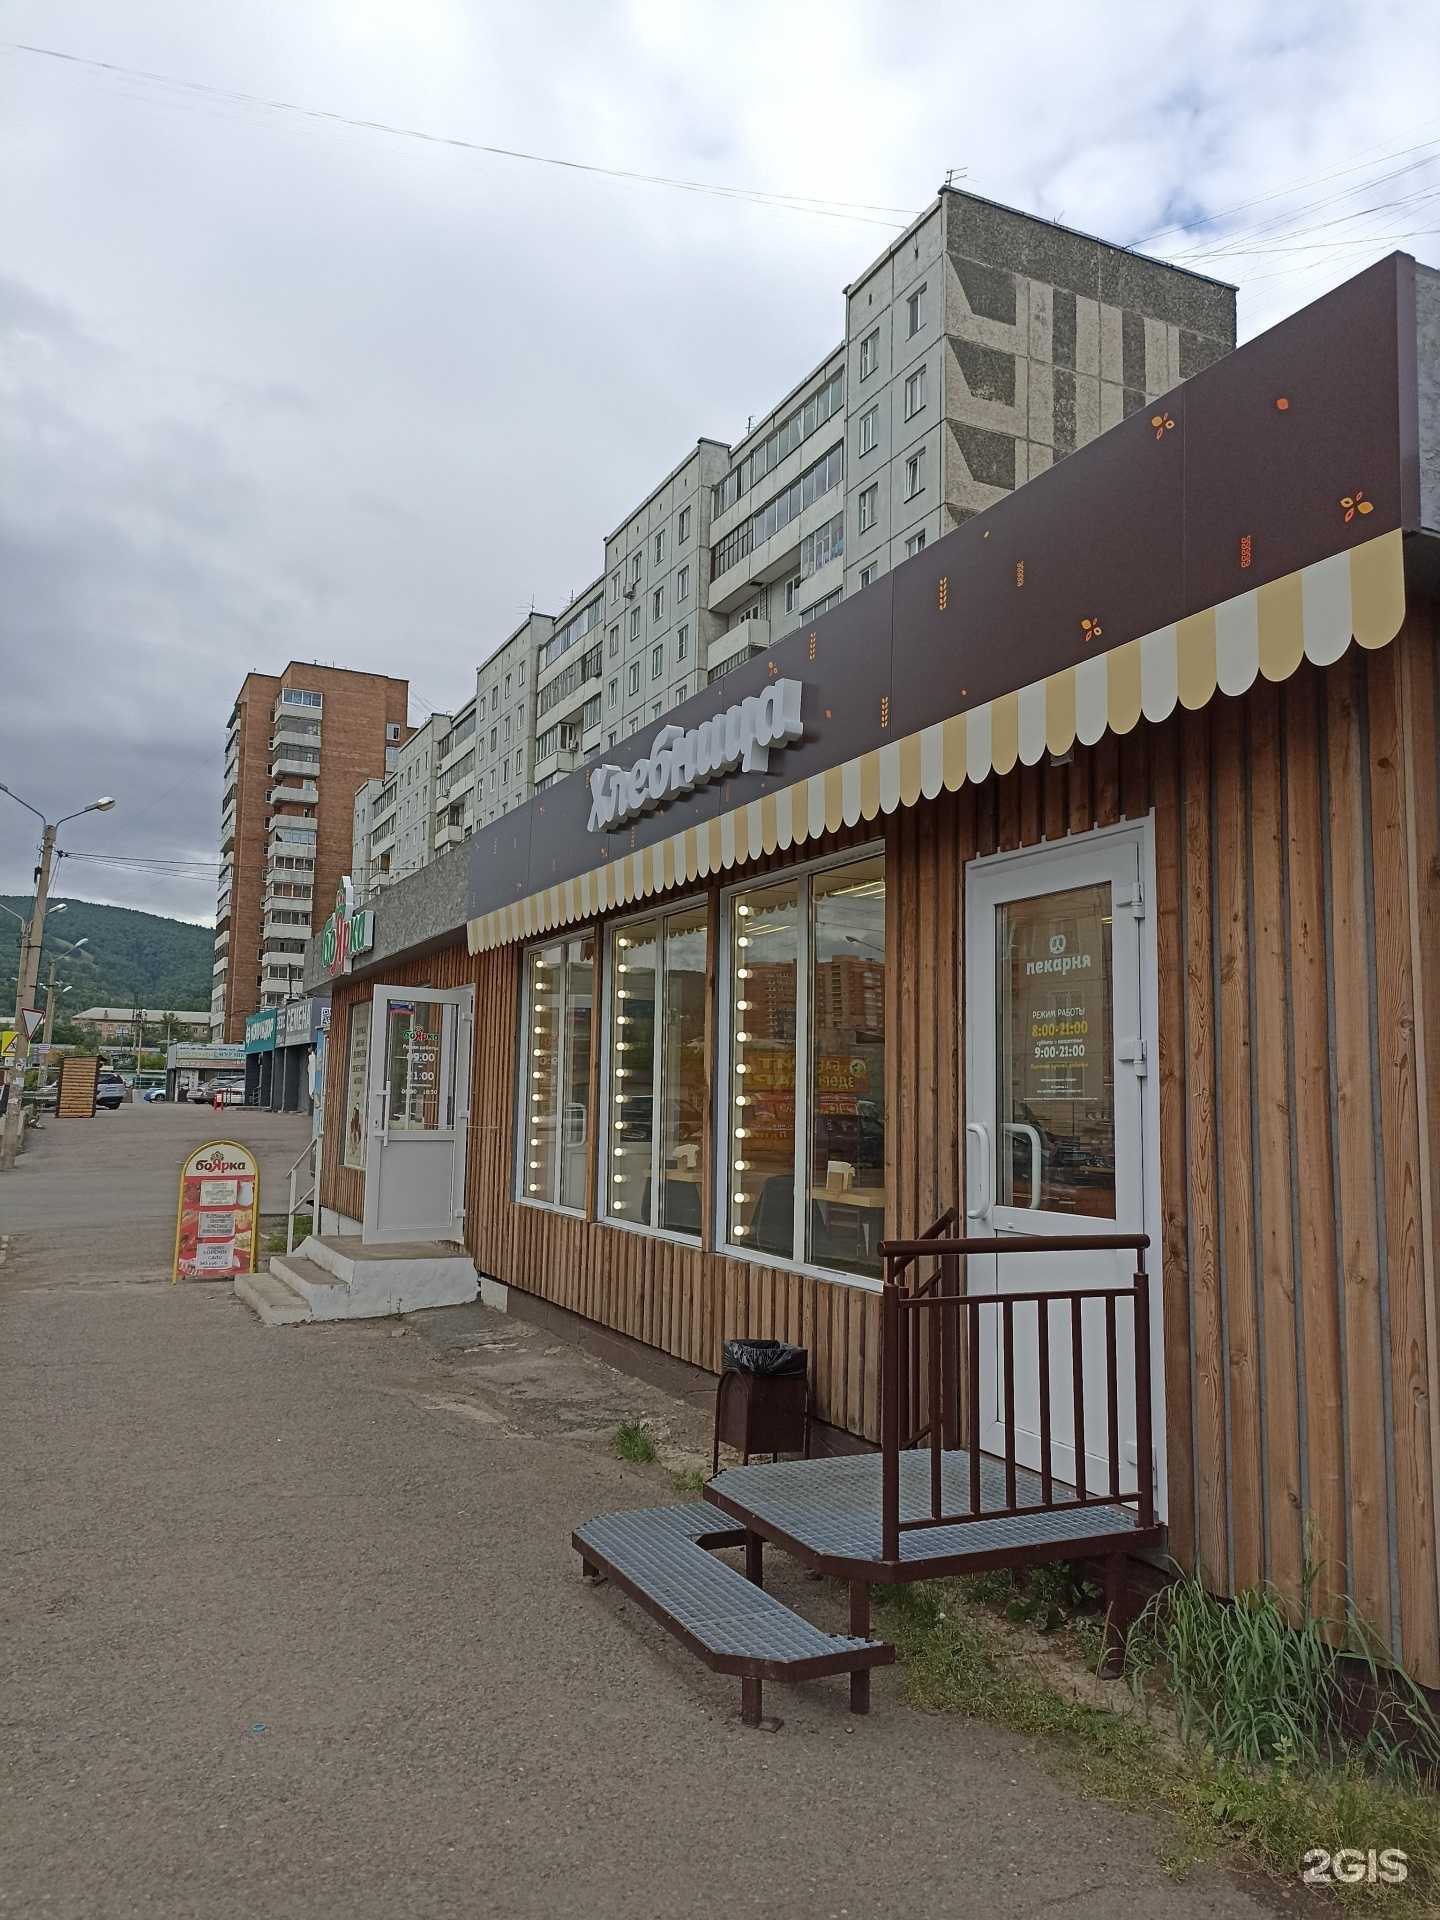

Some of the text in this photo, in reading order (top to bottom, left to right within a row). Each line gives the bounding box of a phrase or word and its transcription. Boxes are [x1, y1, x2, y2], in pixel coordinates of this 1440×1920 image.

[587, 679, 803, 832] Хлебница
[1026, 954, 1091, 976] пекарня
[286, 1003, 311, 1032] СЕМЕНА
[1032, 1007, 1085, 1019] РЕЖИМ РАБОТЫ
